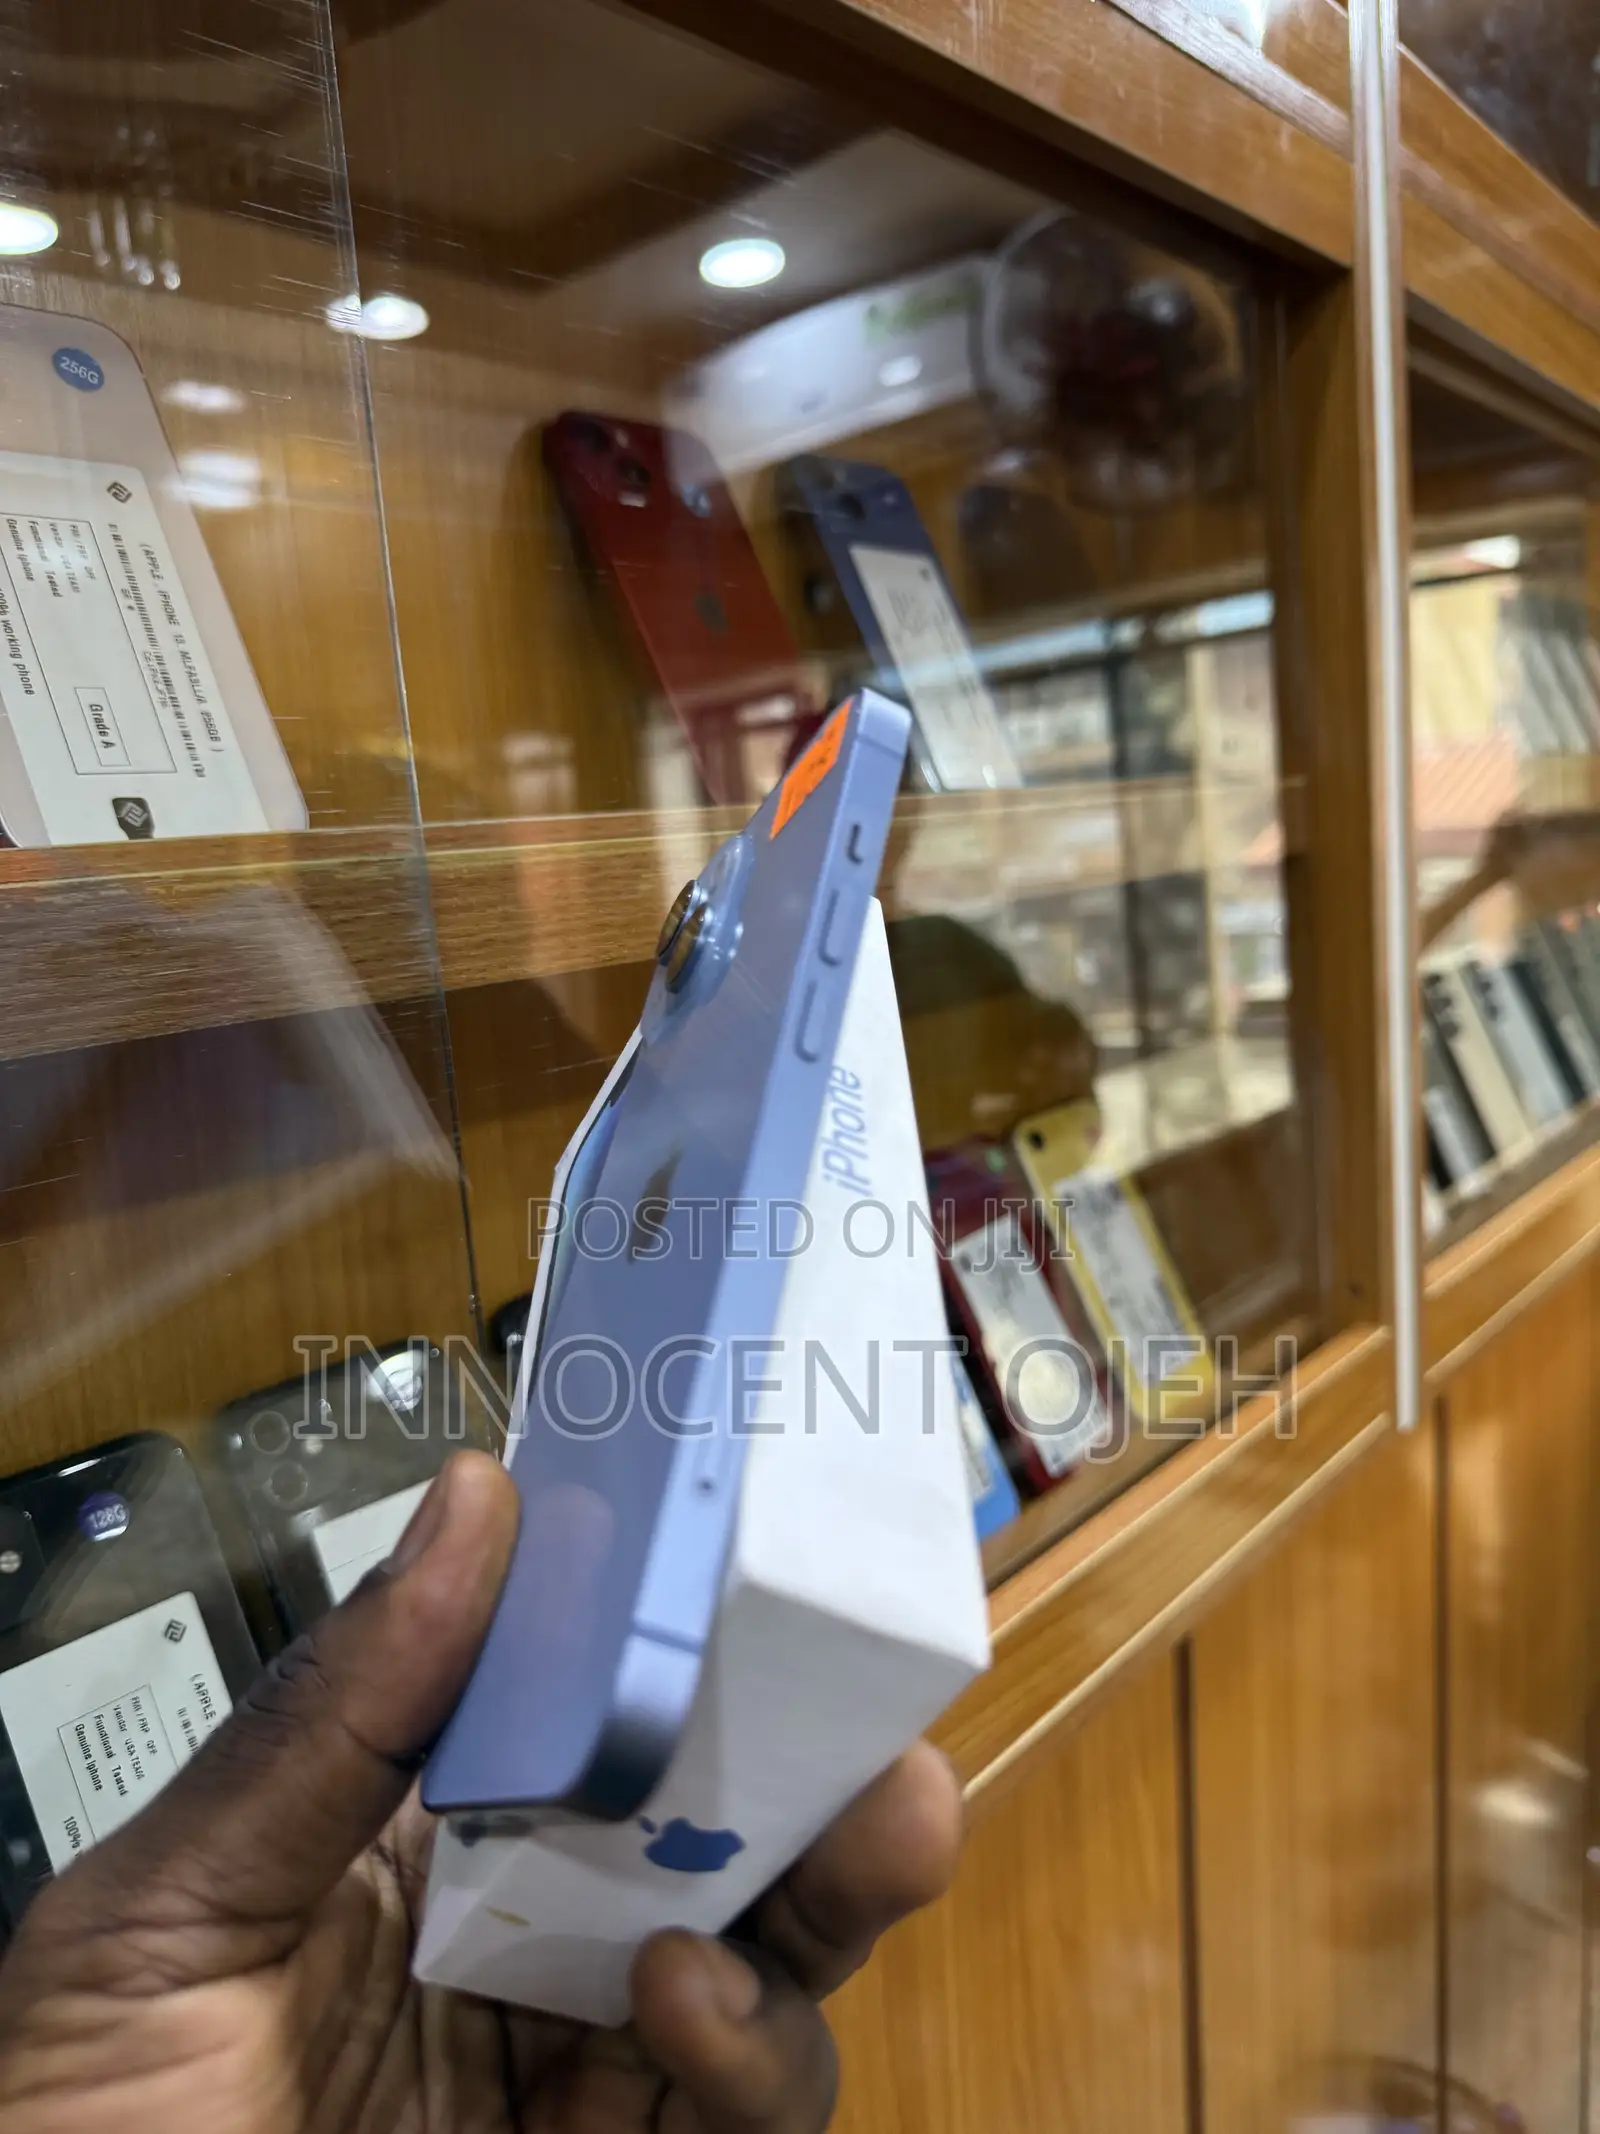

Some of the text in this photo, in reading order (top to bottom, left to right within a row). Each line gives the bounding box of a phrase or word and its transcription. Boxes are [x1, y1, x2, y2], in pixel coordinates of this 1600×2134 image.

[60, 356, 99, 385] 256G
[6, 518, 24, 551] Genuine
[45, 570, 63, 597] Tested
[157, 590, 181, 626] IPHONE
[1, 619, 22, 660] working
[13, 662, 35, 696] phone
[89, 704, 116, 749] Grade A
[821, 1065, 868, 1198] iPhone
[88, 1503, 126, 1529] 128G
[74, 1723, 92, 1760] Genuine
[93, 1713, 129, 1796] Functional Tested
[63, 1816, 83, 1849] 100%
